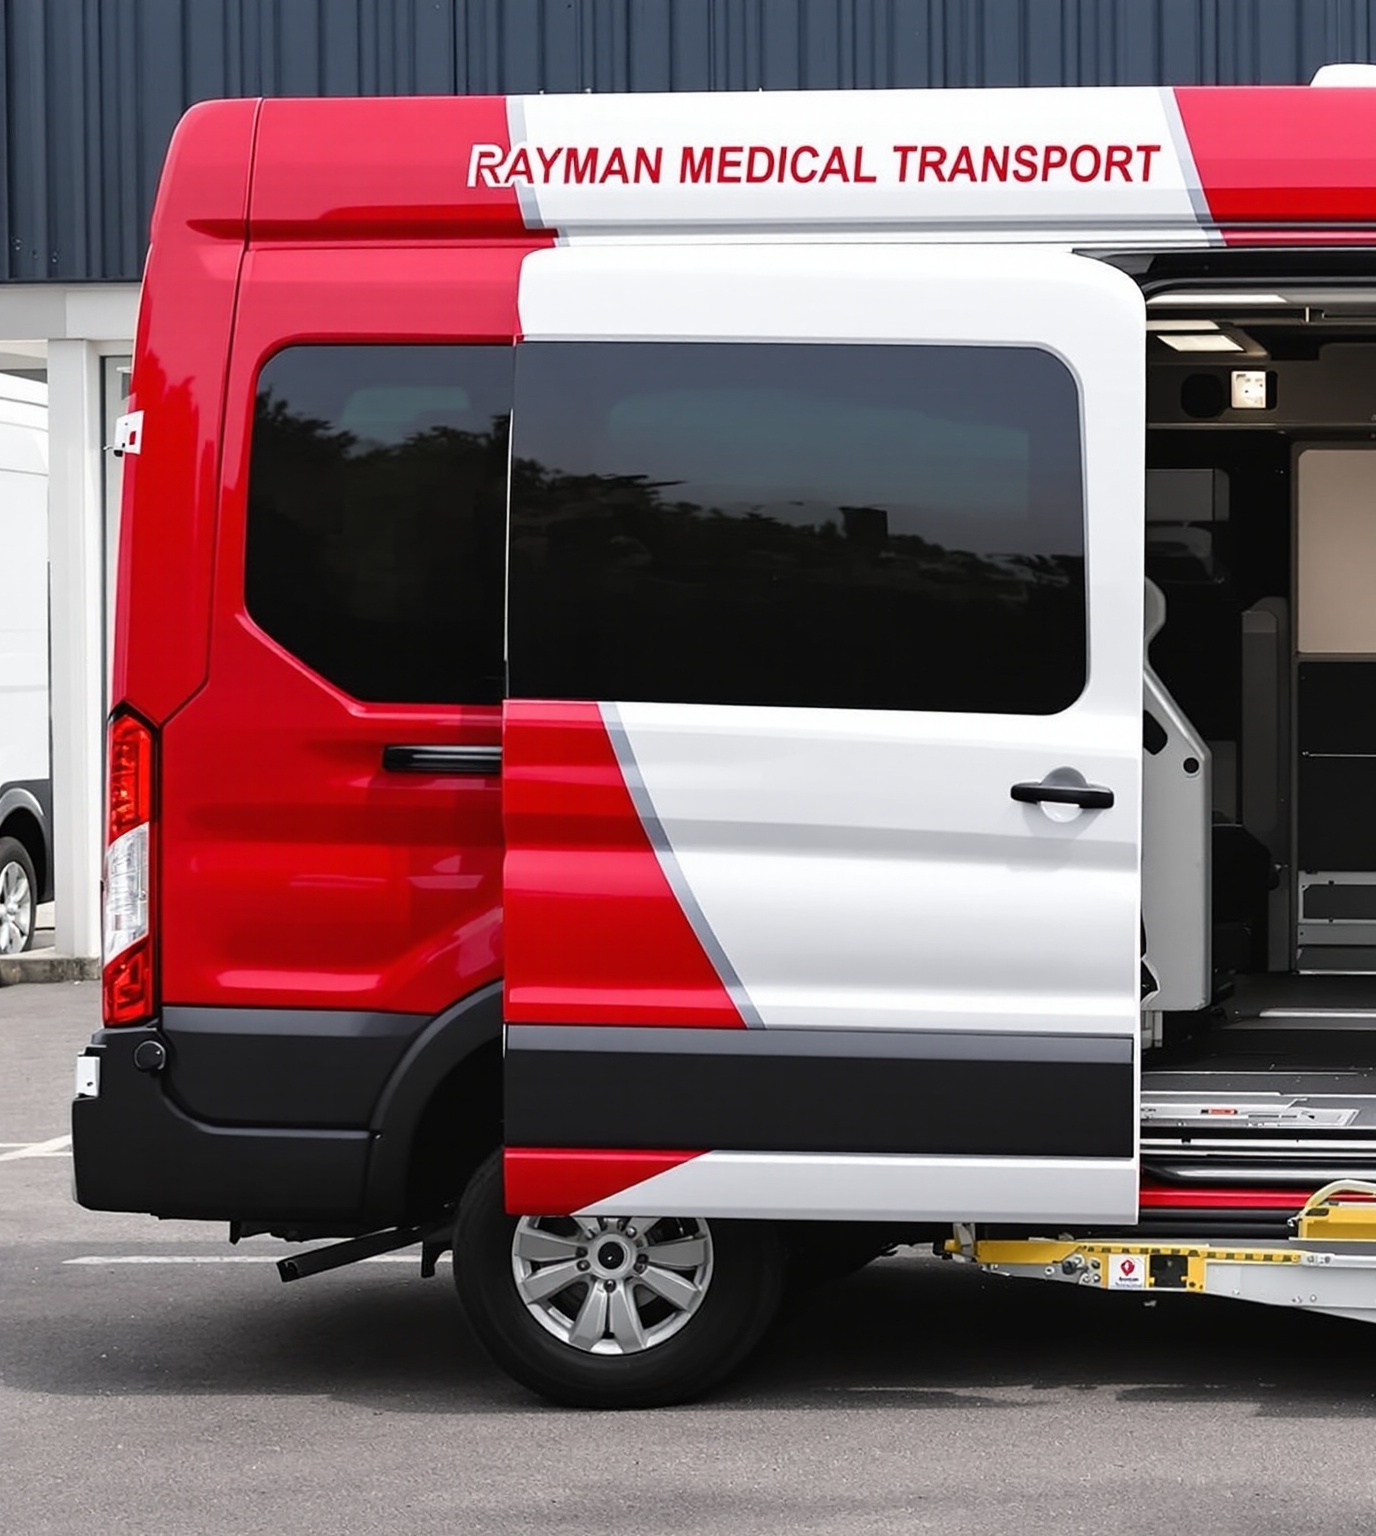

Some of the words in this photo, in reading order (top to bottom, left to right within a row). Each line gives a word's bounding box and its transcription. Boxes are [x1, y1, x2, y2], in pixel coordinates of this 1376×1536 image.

[467, 144, 663, 187] RAYMAN
[677, 145, 876, 184] MEDICAL
[893, 144, 1162, 183] TRANSPORT
